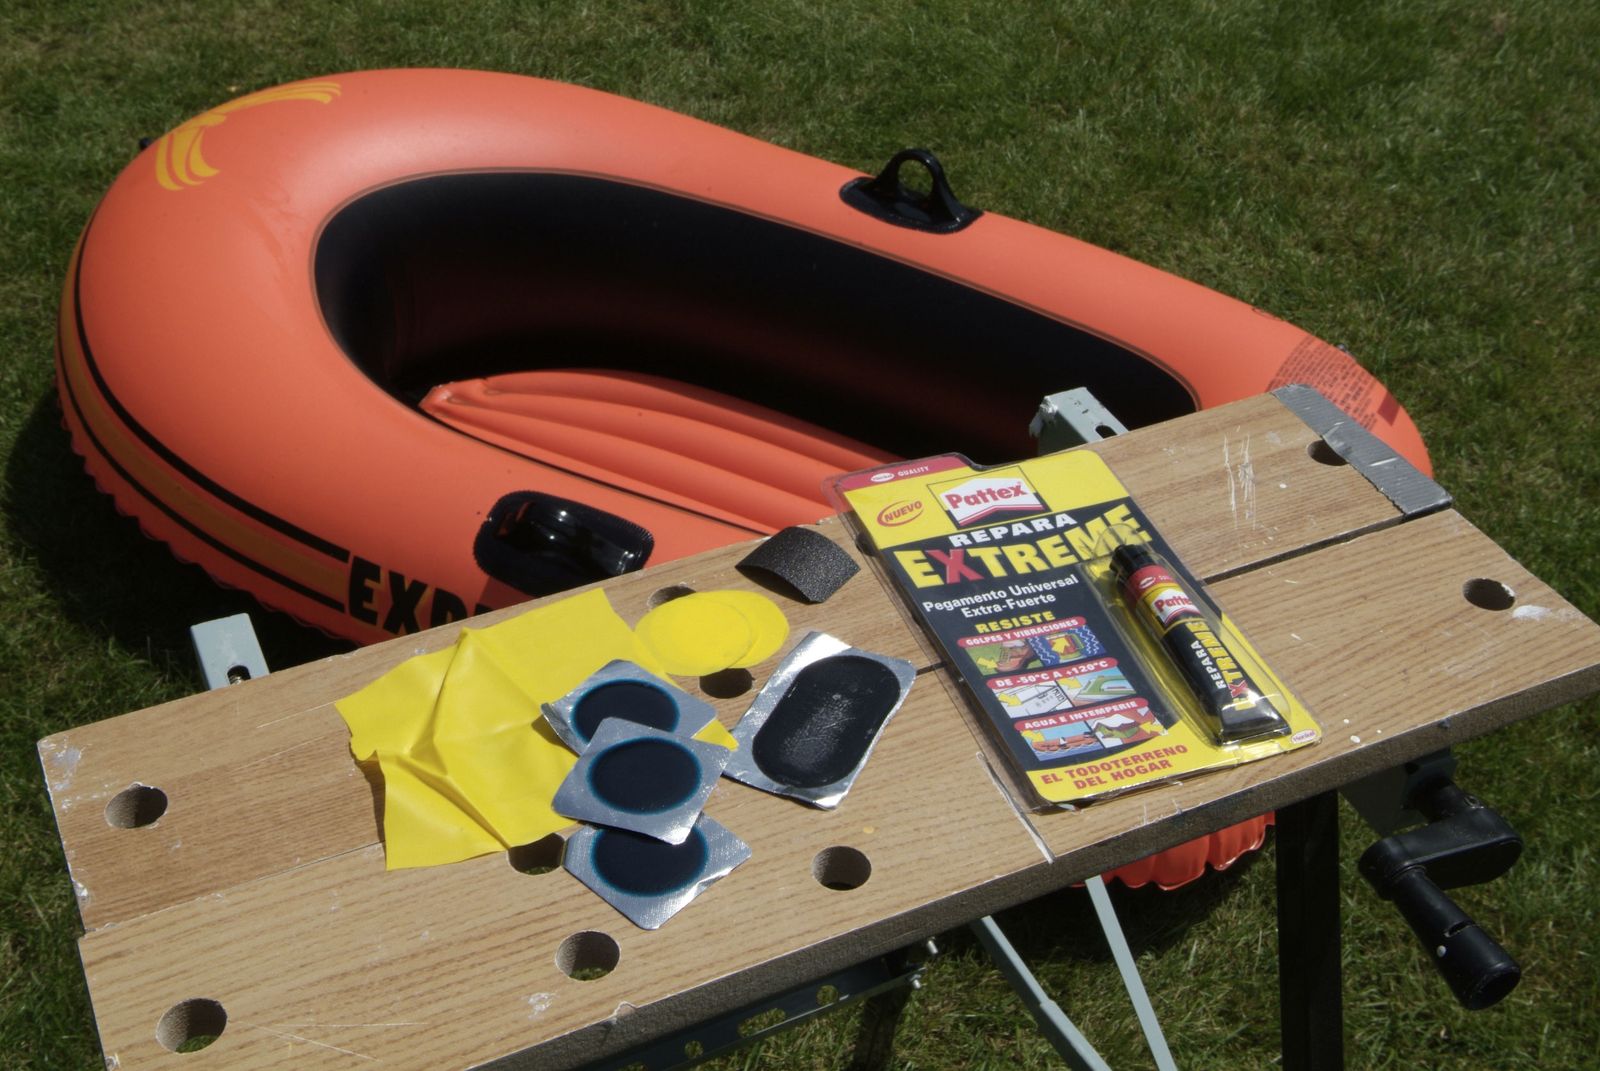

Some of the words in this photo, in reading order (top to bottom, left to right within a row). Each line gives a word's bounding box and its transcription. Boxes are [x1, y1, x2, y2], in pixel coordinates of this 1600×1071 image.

[897, 466, 929, 477] QUALITY
[945, 483, 1027, 509] Pattex
[884, 500, 923, 523] NUEVO
[949, 513, 1077, 548] REPARA
[893, 504, 1153, 589] EXTREME
[349, 555, 496, 634] EXP
[922, 589, 1007, 613] Pegamento
[1009, 574, 1079, 595] Universal
[961, 594, 1057, 619] Extra-Fuerte
[1154, 596, 1192, 612] Patte
[966, 633, 1003, 646] GOLPES
[1014, 618, 1079, 638] VIBRACIONES
[975, 611, 1056, 634] RESISTE
[995, 679, 1014, 688] DE
[1053, 670, 1062, 679] A
[1190, 640, 1227, 690] REPARA
[1024, 718, 1057, 730] AGUA
[1059, 715, 1067, 723] E
[1070, 701, 1138, 721] INTEMPERIE
[1041, 774, 1062, 785] EL
[1065, 744, 1188, 780] TODOTERRENO
[1074, 778, 1107, 790] DEL
[1112, 759, 1173, 782] HOGAR
